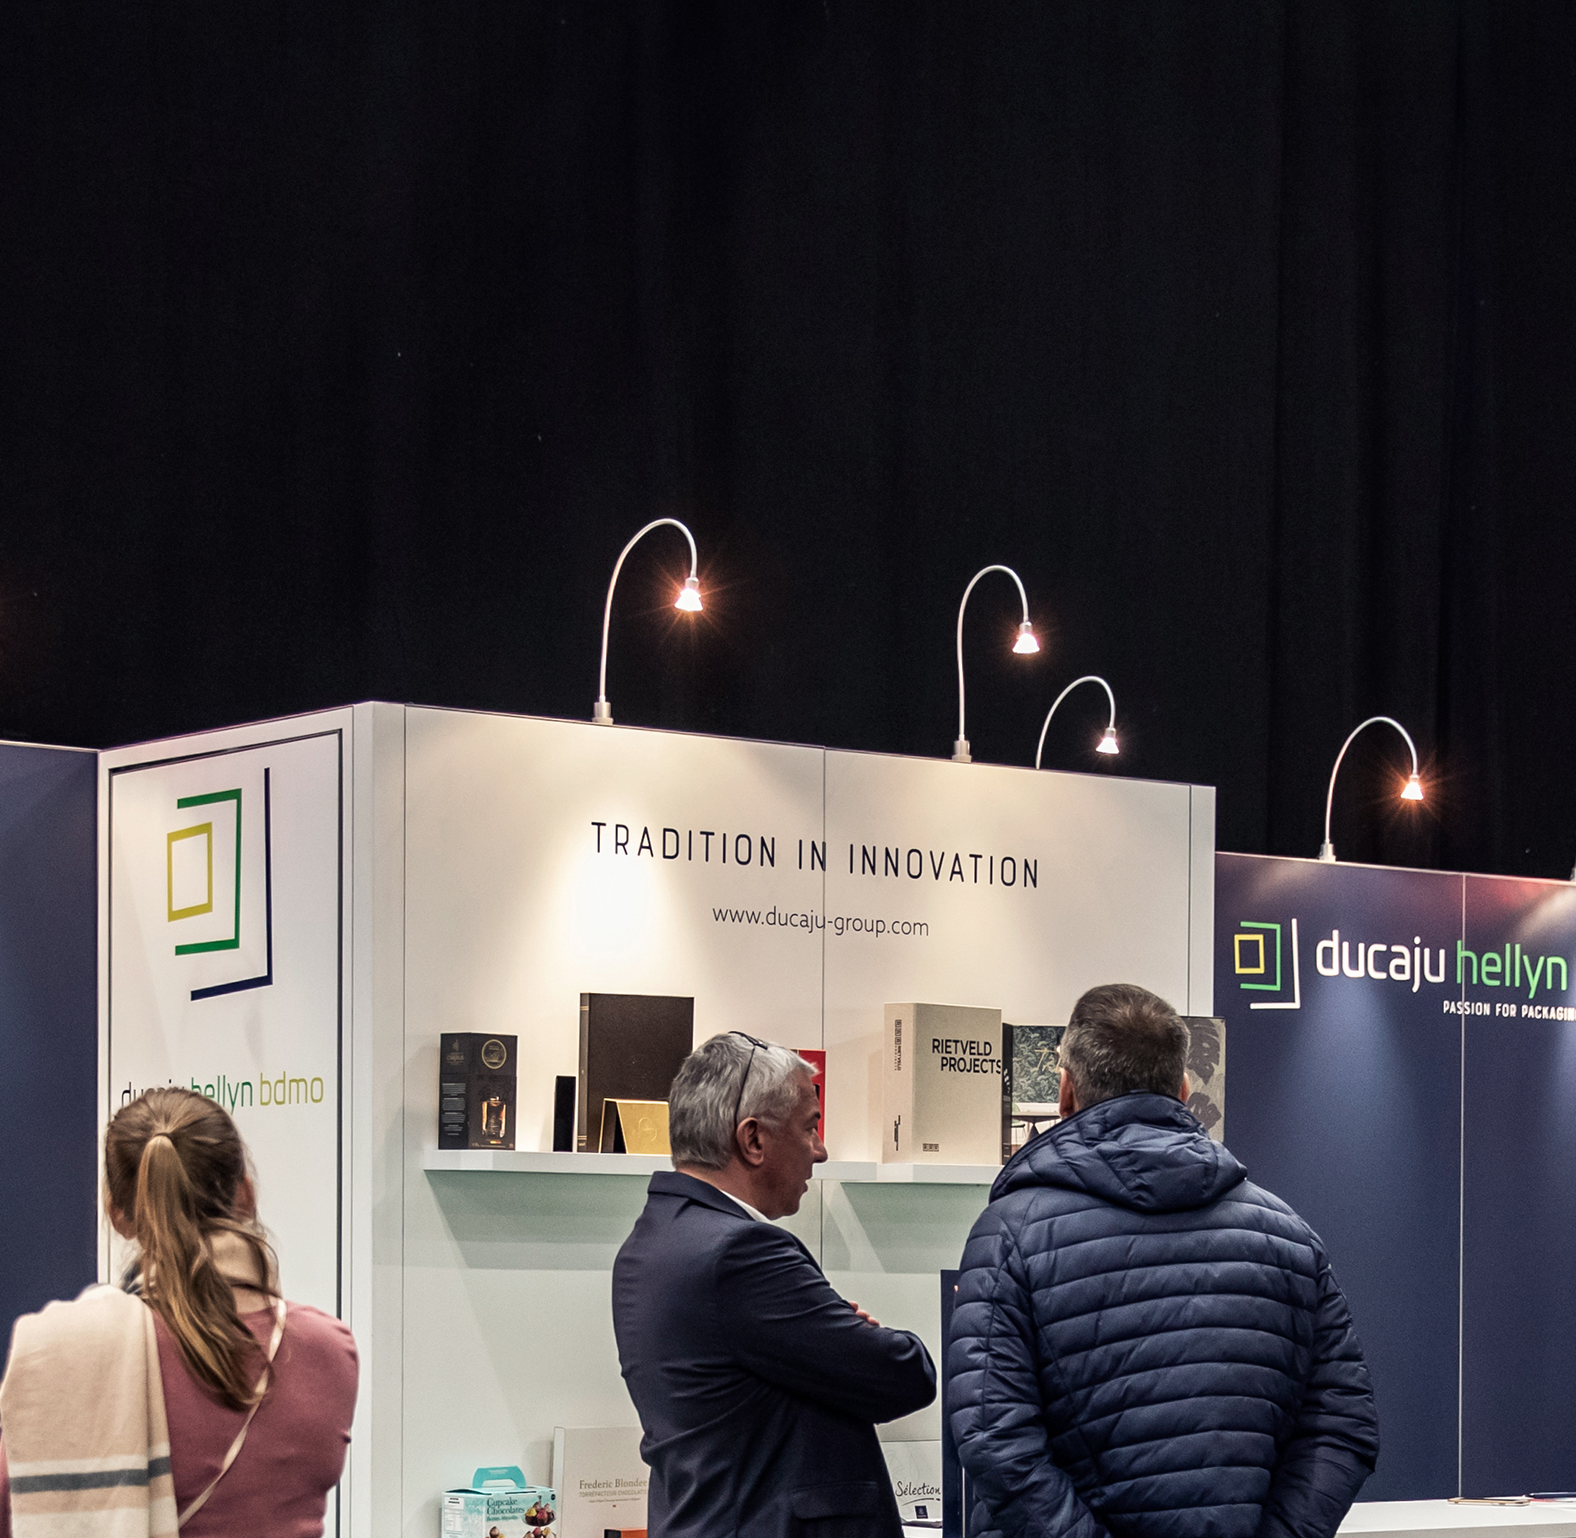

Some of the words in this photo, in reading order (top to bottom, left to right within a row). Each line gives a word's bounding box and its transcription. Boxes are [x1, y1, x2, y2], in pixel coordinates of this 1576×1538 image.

[591, 821, 776, 868] TRADITION
[798, 839, 827, 872] IN
[849, 843, 1039, 889] INNOVATION
[712, 906, 930, 937] www.ducaju-group.com
[1316, 929, 1446, 993] ducaju
[1456, 940, 1567, 999] hellyn
[1443, 1000, 1491, 1016] PASSION
[1495, 1003, 1517, 1018] FOR
[931, 1038, 993, 1057] RIETVELD
[940, 1056, 1002, 1075] PROJECTS
[260, 1071, 324, 1107] bdmo
[579, 1479, 613, 1490] Frederic
[895, 1481, 941, 1497] Sélection
[486, 1497, 518, 1510] Cupcake
